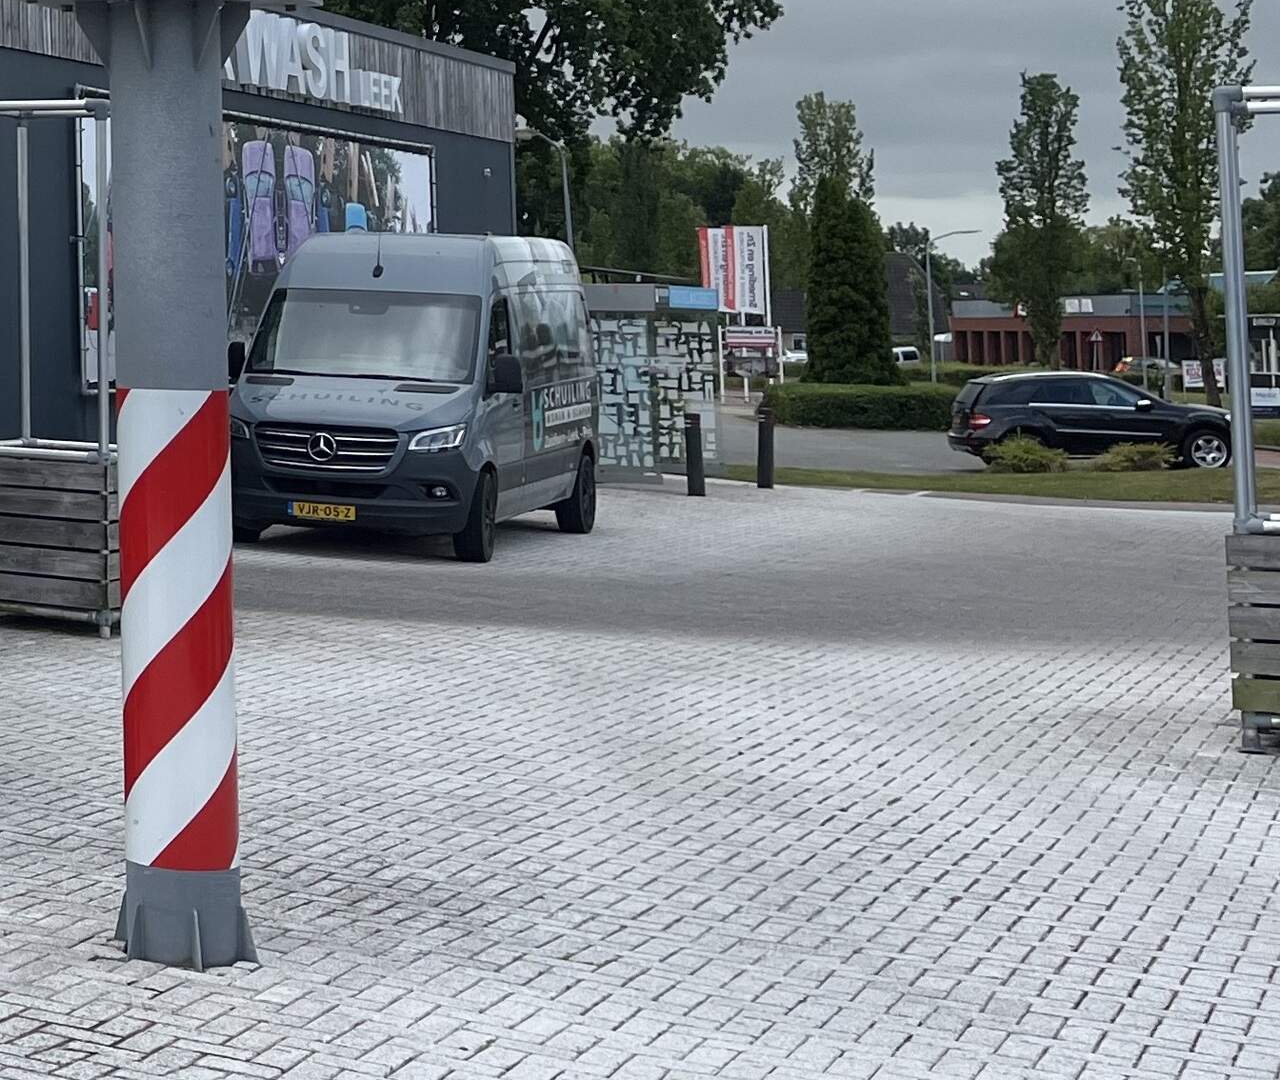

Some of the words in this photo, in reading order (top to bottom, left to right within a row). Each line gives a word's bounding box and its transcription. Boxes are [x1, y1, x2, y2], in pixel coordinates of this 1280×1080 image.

[241, 9, 351, 104] WASH
[358, 69, 404, 114] LEEK
[249, 391, 424, 412] SCHUILING
[544, 381, 592, 409] SCHUILING
[297, 503, 351, 518] VJR-05-Z
